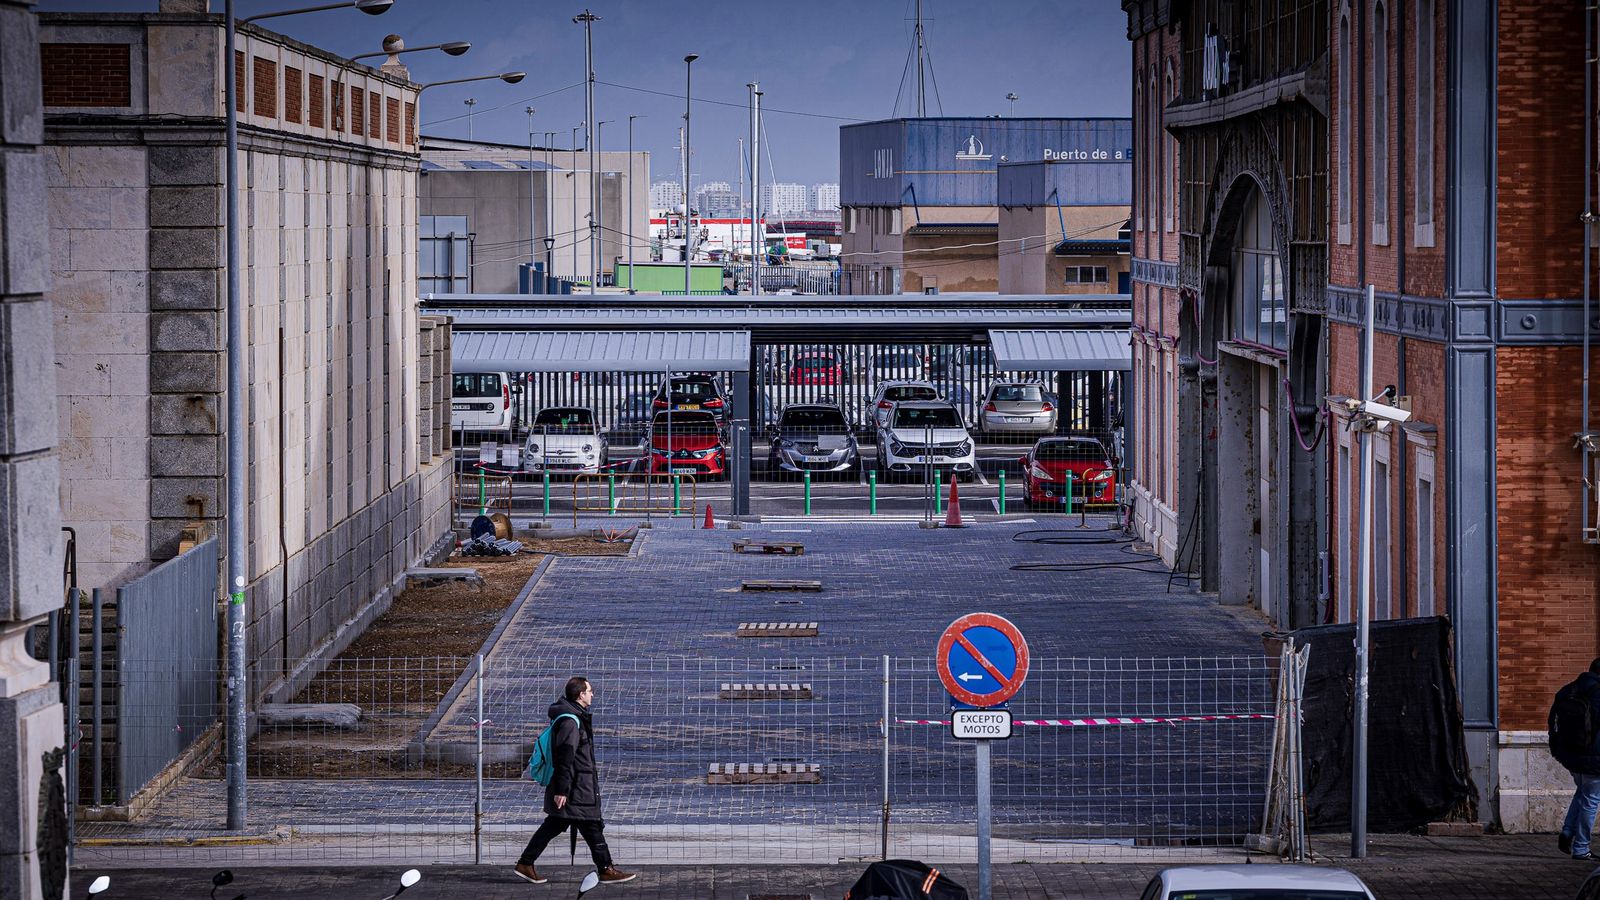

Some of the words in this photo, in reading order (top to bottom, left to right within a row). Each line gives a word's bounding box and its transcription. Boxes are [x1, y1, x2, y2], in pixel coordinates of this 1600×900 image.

[1043, 148, 1088, 160] Puerto
[1091, 148, 1108, 160] de
[960, 714, 1004, 724] EXCEPTO
[963, 725, 1001, 734] MOTOS
